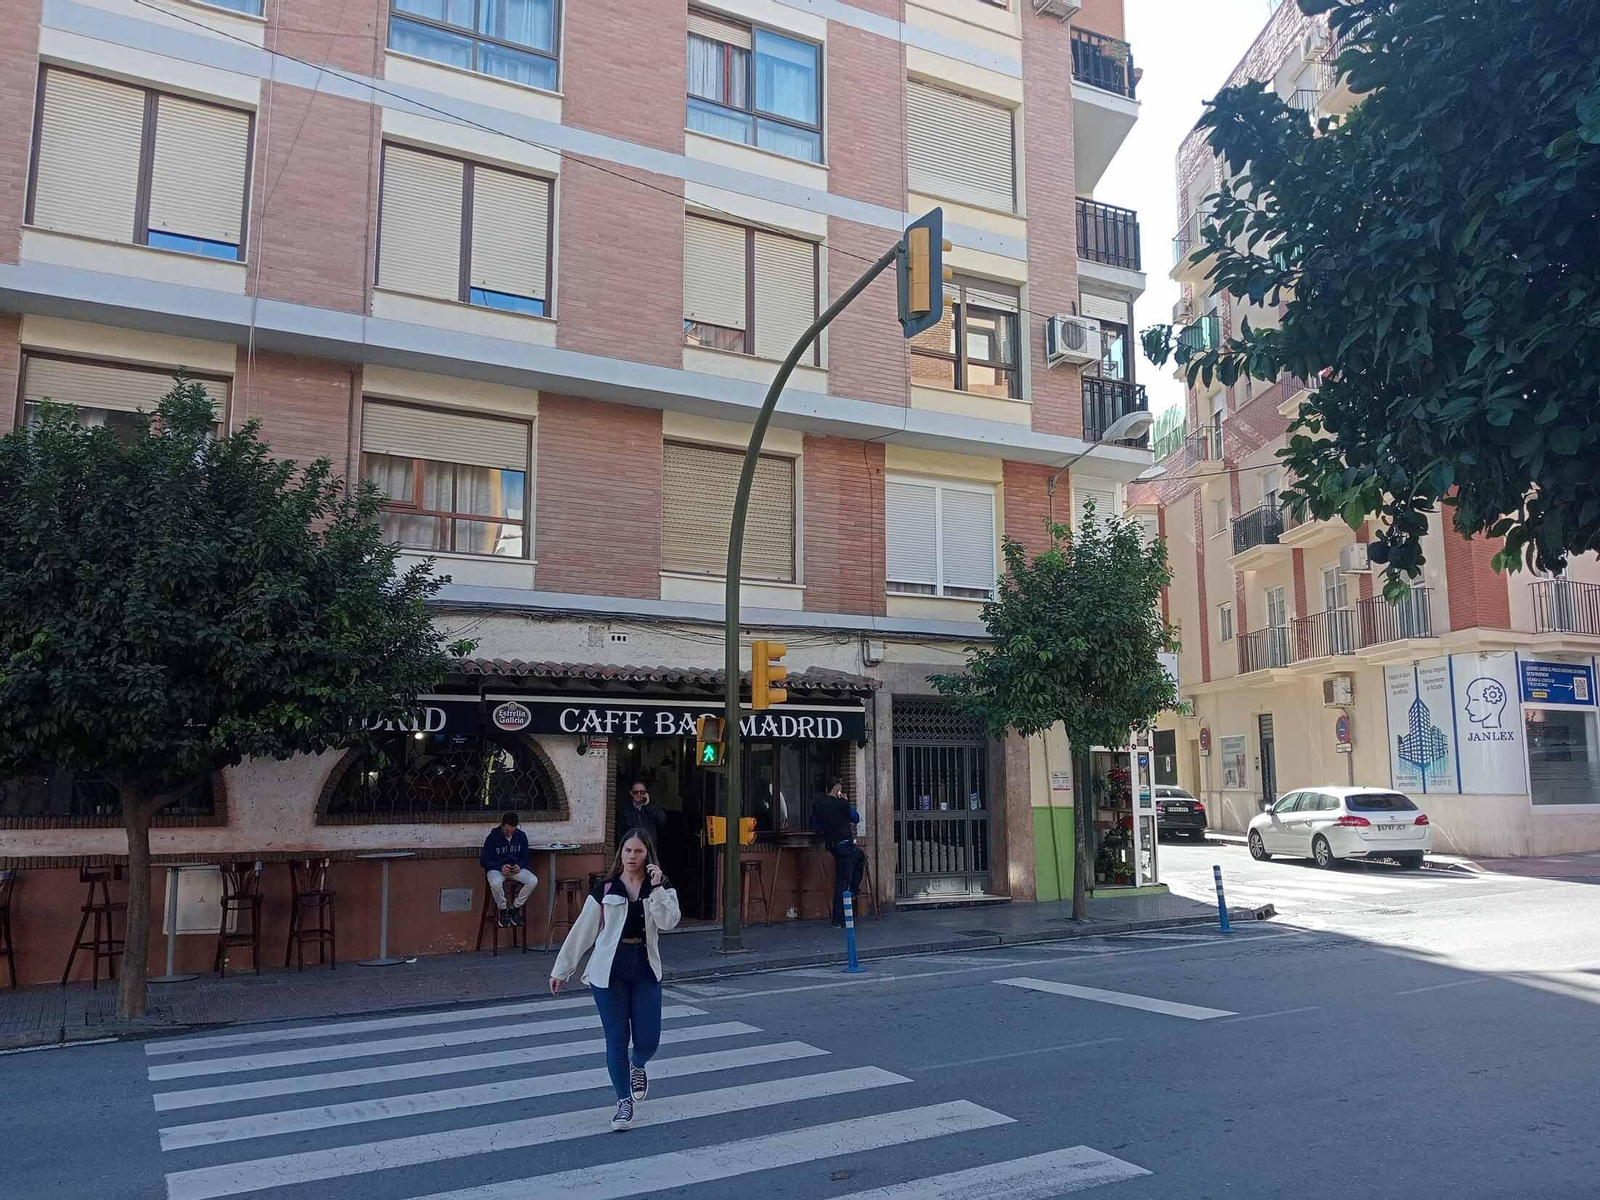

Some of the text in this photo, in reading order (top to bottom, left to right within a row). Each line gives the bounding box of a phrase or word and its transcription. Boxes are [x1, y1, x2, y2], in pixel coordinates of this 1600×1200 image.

[559, 708, 843, 739] CAFE BA MADRID
[1467, 731, 1515, 742] JANLEX
